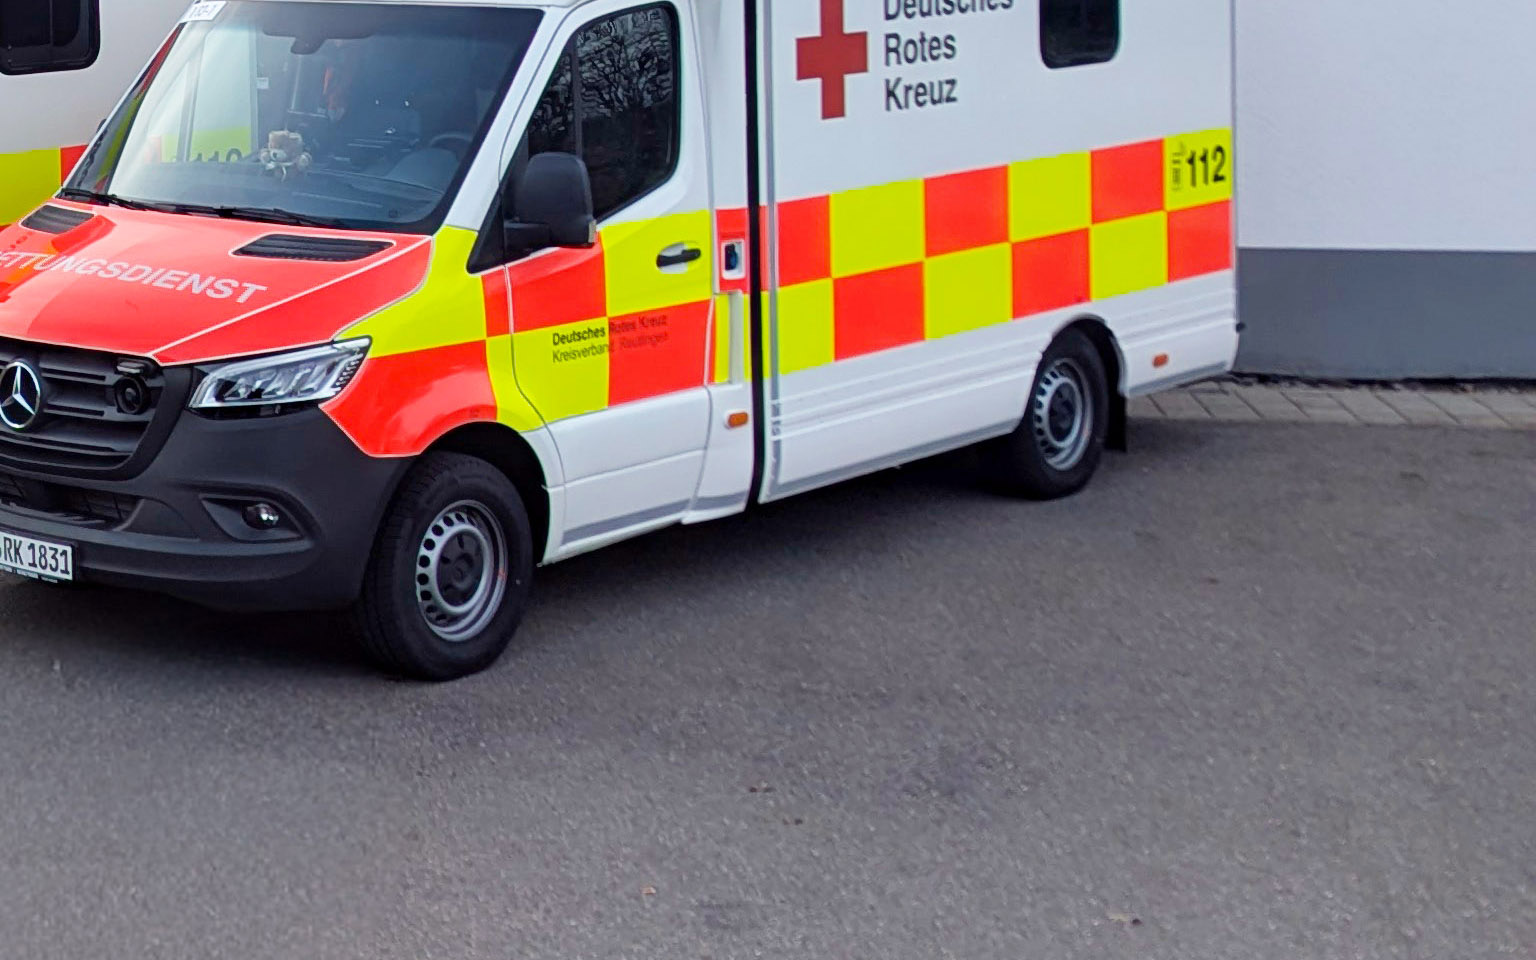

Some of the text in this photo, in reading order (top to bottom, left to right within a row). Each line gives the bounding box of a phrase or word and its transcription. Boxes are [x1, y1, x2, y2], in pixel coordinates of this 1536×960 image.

[884, 31, 956, 67] Rotes
[885, 77, 957, 112] Kreuz
[1187, 145, 1226, 188] 112
[552, 326, 606, 346] Deutsches
[3, 536, 24, 566] RK
[27, 543, 70, 575] 1831
